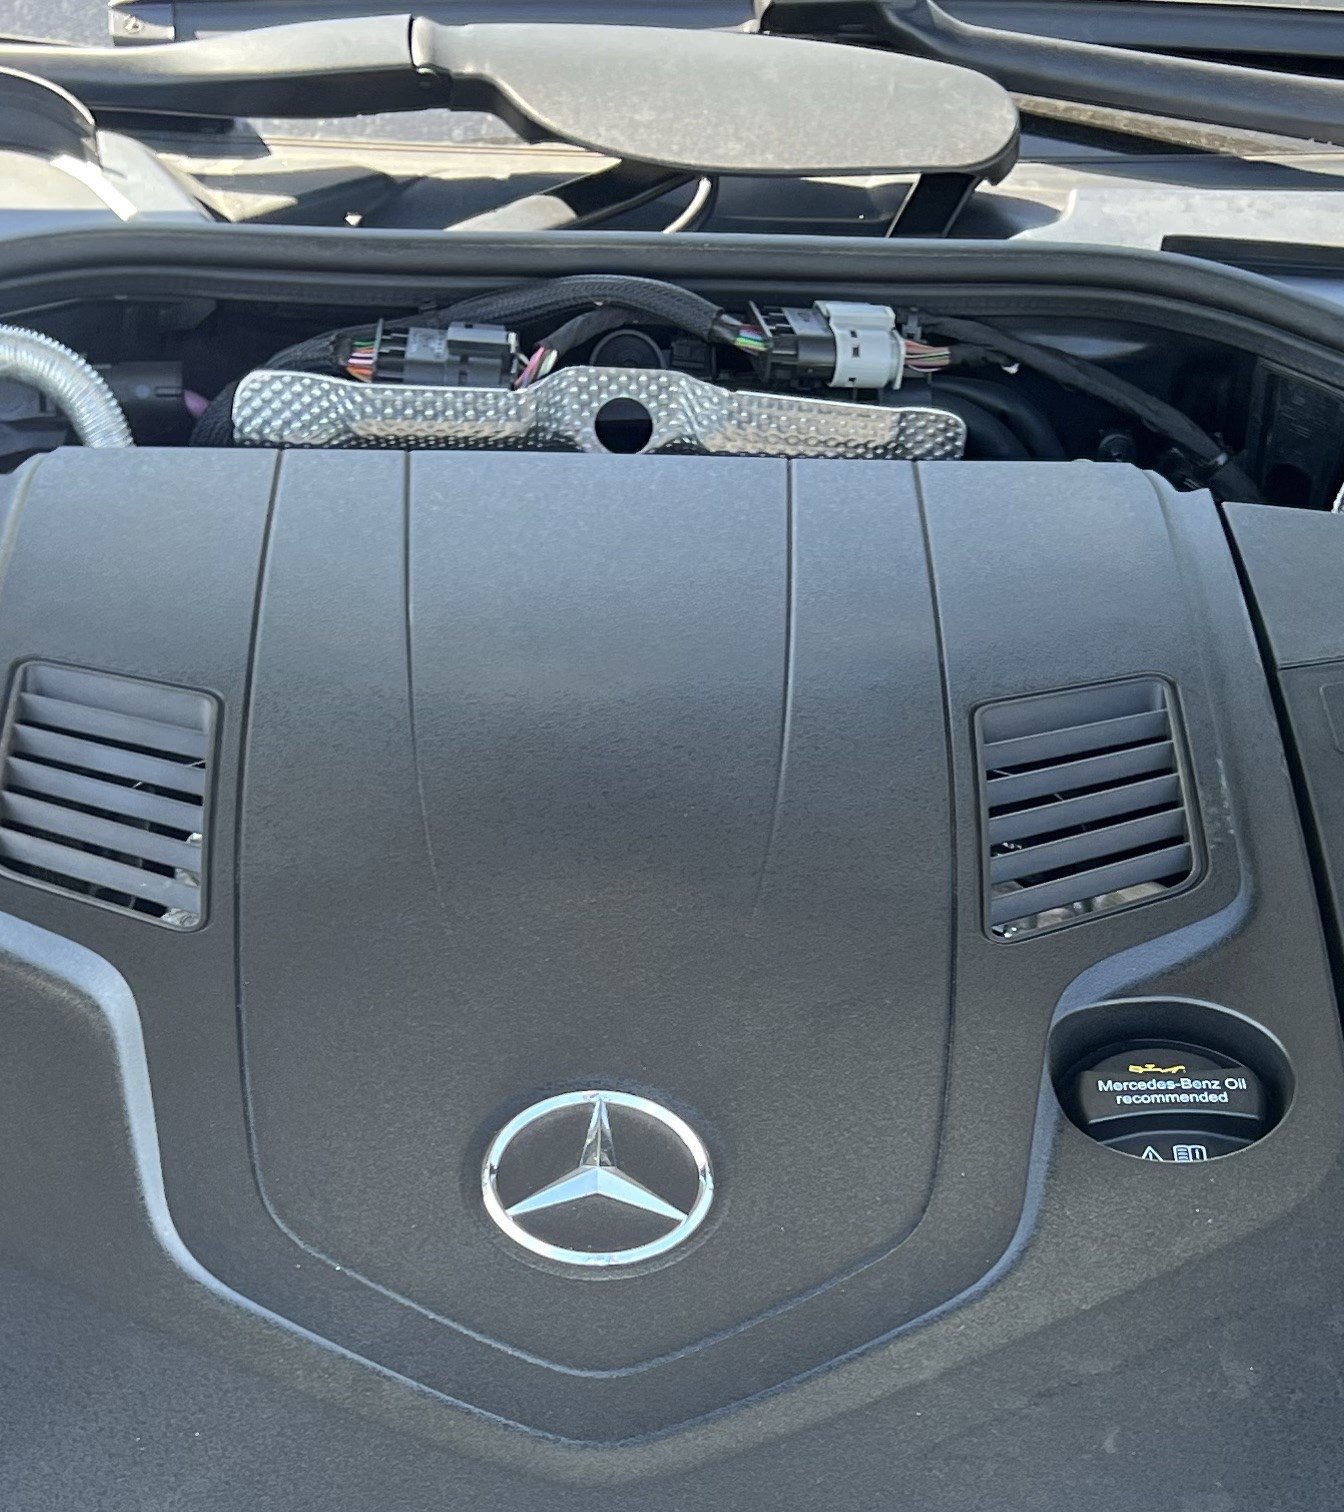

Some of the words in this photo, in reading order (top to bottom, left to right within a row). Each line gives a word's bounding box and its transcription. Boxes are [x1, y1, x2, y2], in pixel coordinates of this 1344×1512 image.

[1097, 1077, 1222, 1092] Mercedes-Benz
[1224, 1077, 1247, 1090] Oil
[1116, 1091, 1229, 1105] recommended
